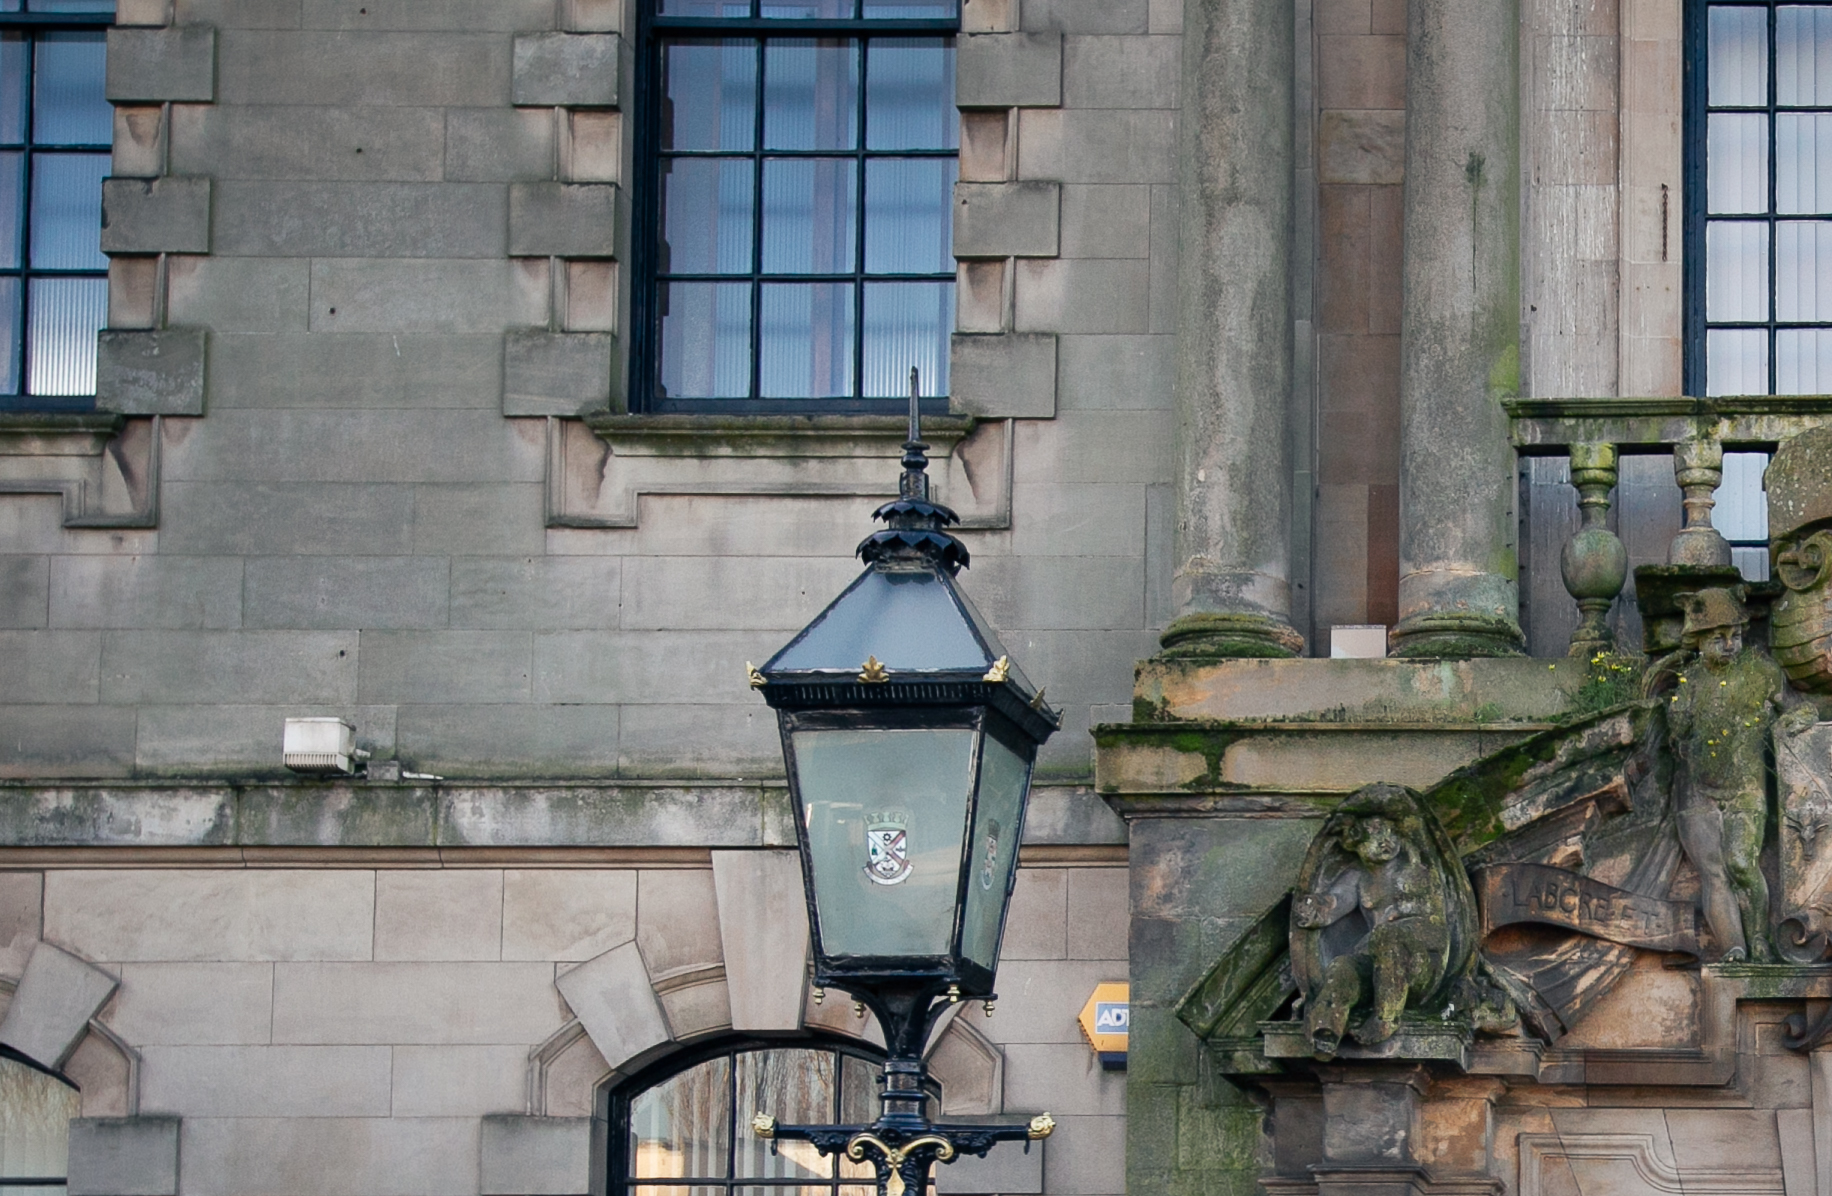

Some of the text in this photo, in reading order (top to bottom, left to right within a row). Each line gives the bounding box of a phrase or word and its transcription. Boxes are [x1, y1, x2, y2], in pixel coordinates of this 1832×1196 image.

[1511, 877, 1660, 935] LABORE ET
[1097, 1008, 1129, 1026] ADT
